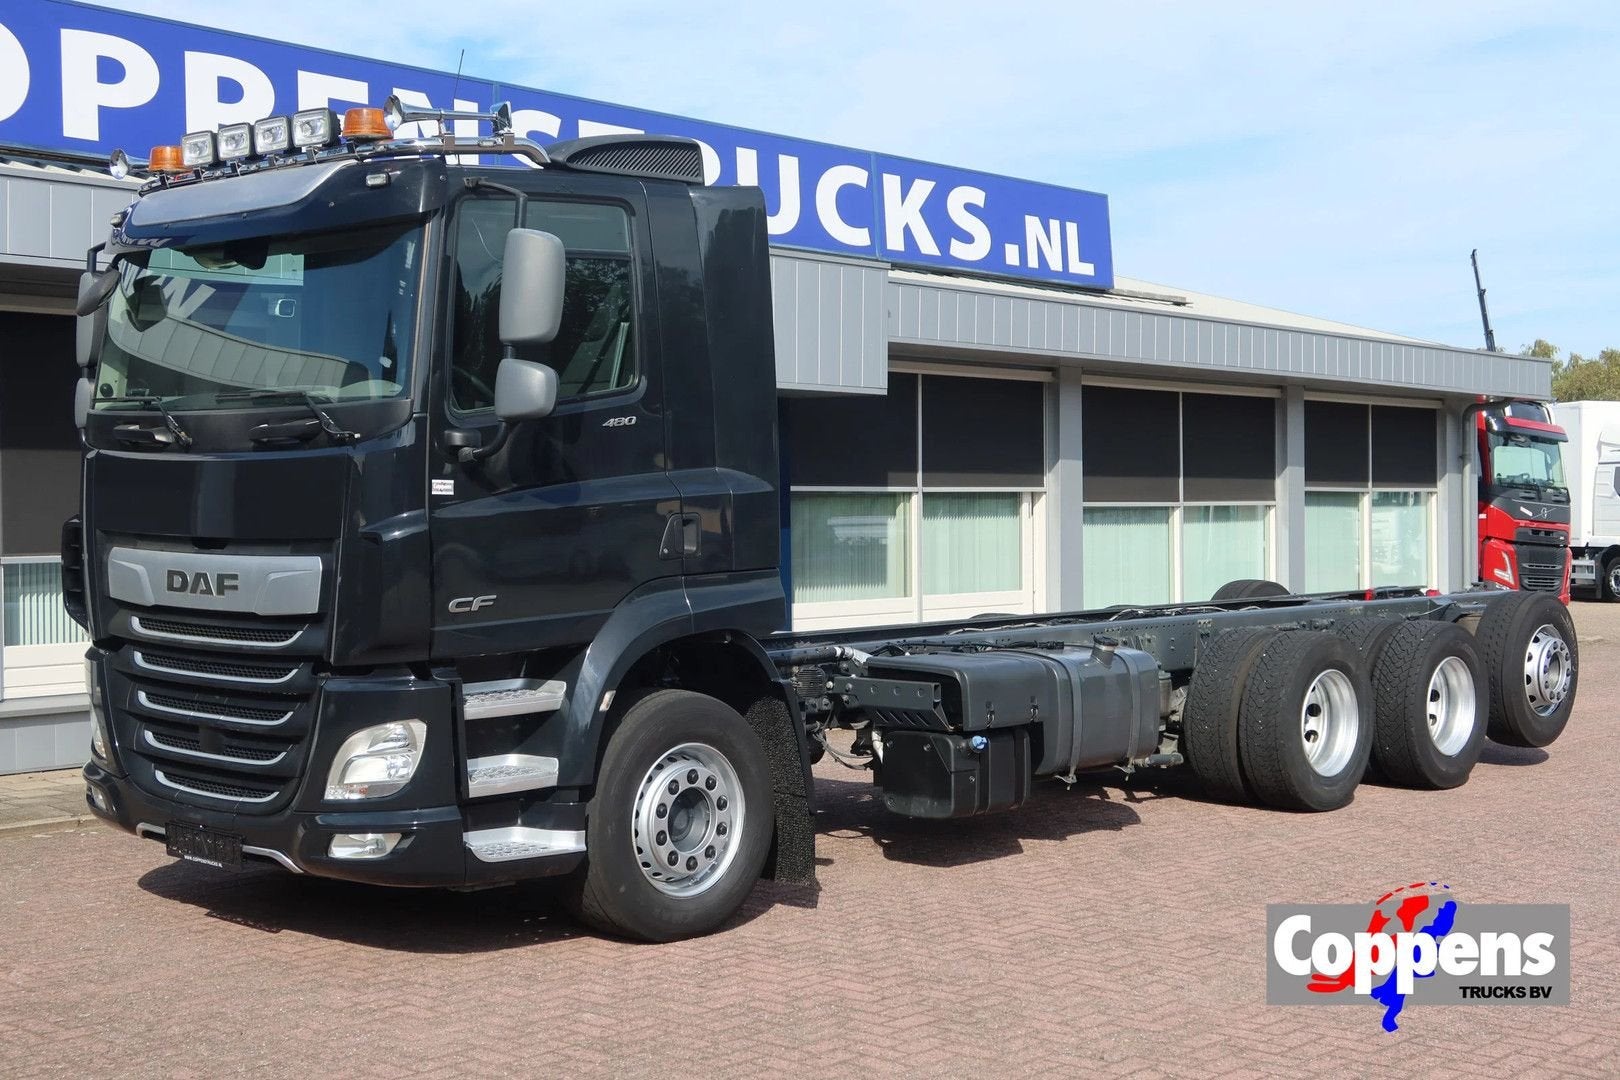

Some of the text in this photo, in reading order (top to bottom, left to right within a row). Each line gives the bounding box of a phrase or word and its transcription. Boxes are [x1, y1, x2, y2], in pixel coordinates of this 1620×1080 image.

[602, 415, 636, 427] 480
[166, 569, 239, 596] DAF
[448, 595, 497, 613] CF
